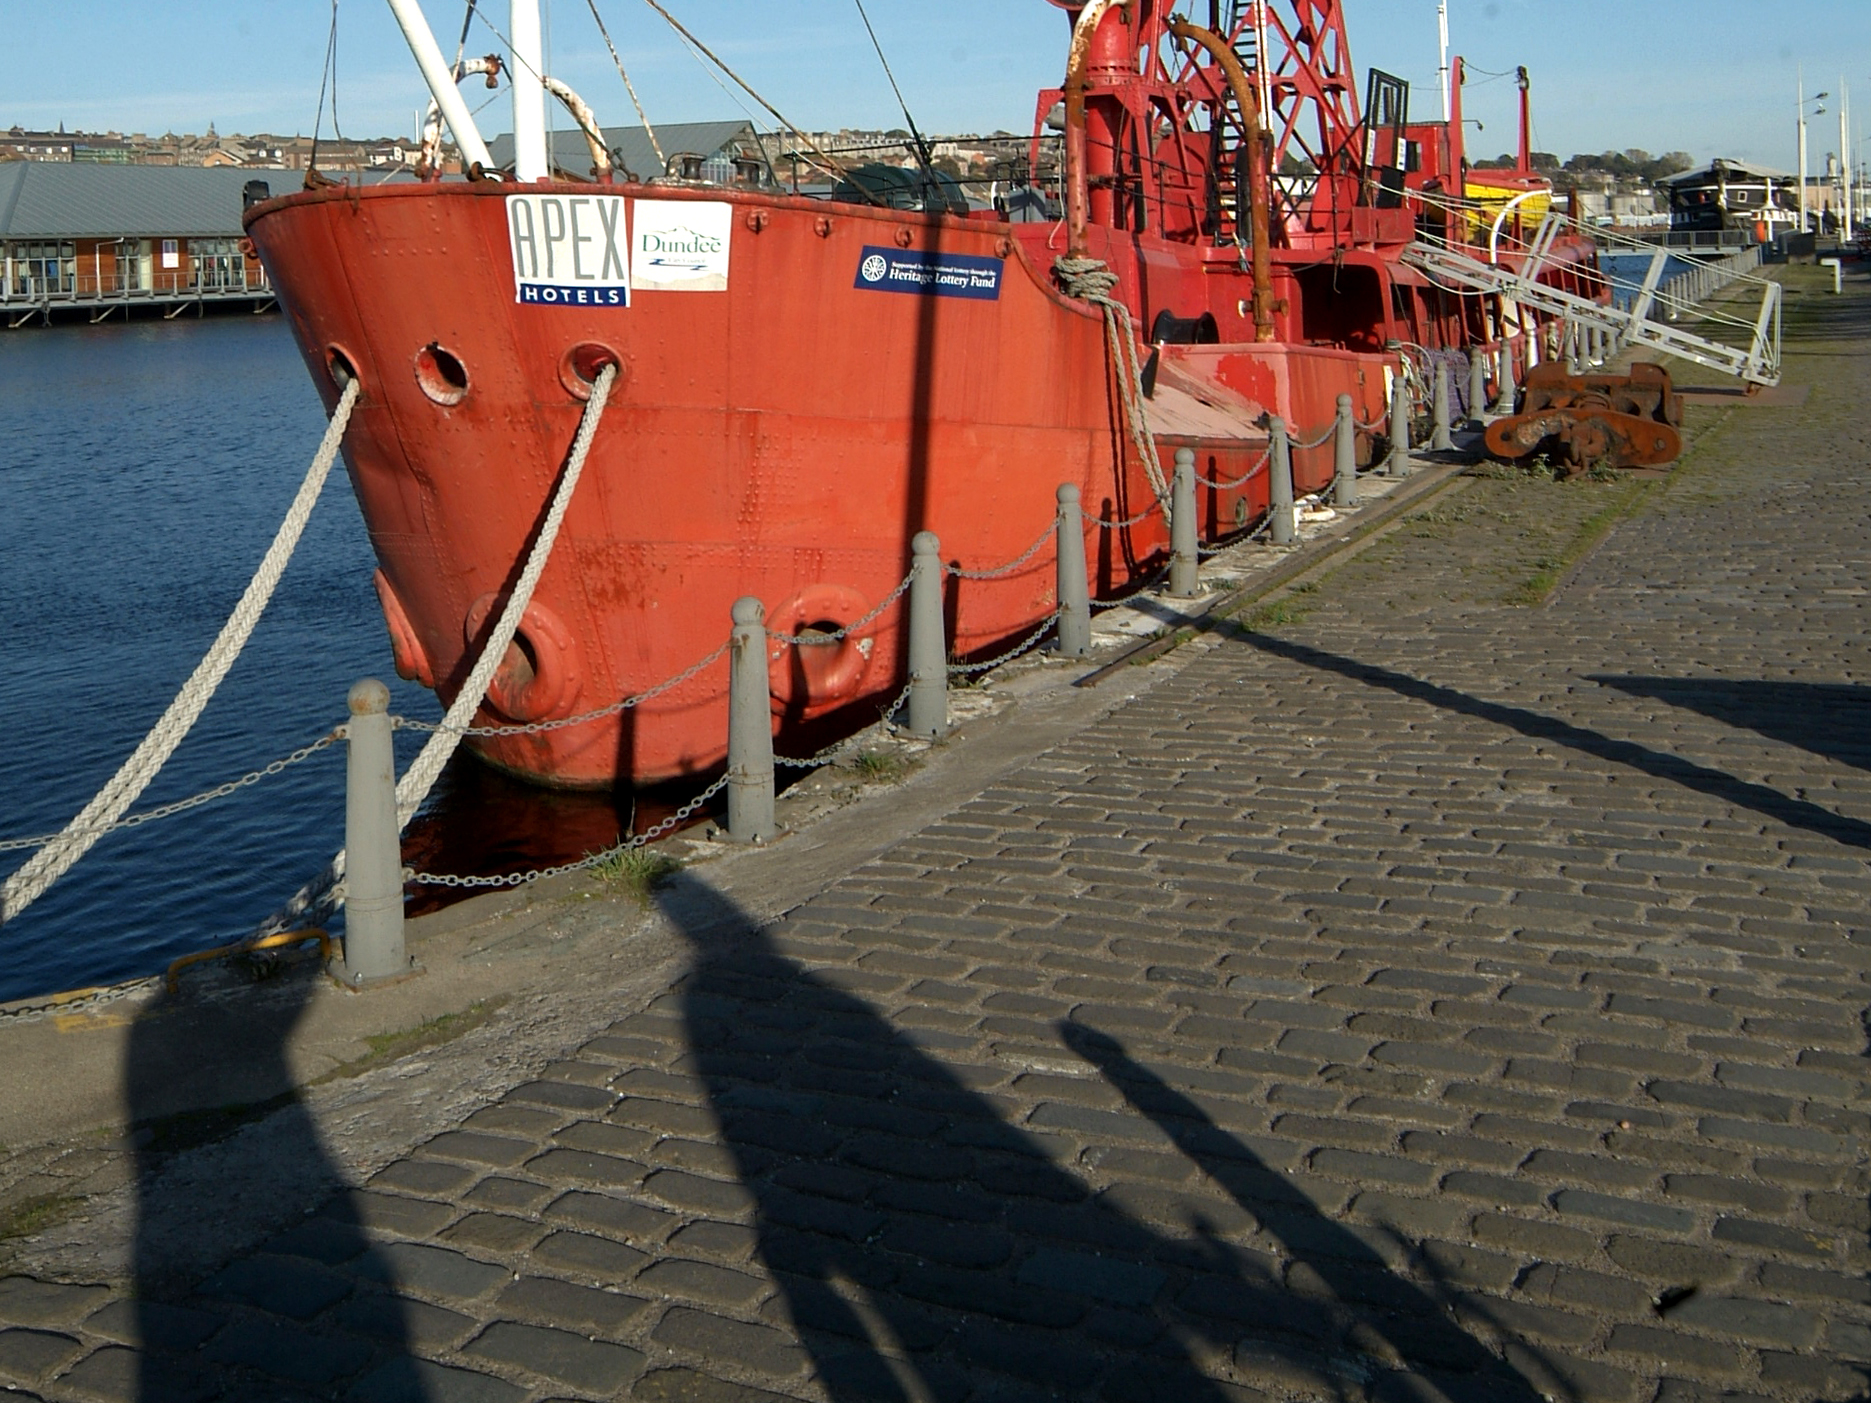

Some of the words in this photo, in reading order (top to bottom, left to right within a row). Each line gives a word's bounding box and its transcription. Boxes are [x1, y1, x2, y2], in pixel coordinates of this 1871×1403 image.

[511, 198, 625, 280] APEX
[642, 234, 721, 254] Dundee
[889, 269, 932, 285] Heritage
[935, 272, 969, 288] Lottery
[970, 276, 996, 288] Fund
[525, 286, 619, 304] HOTELS
